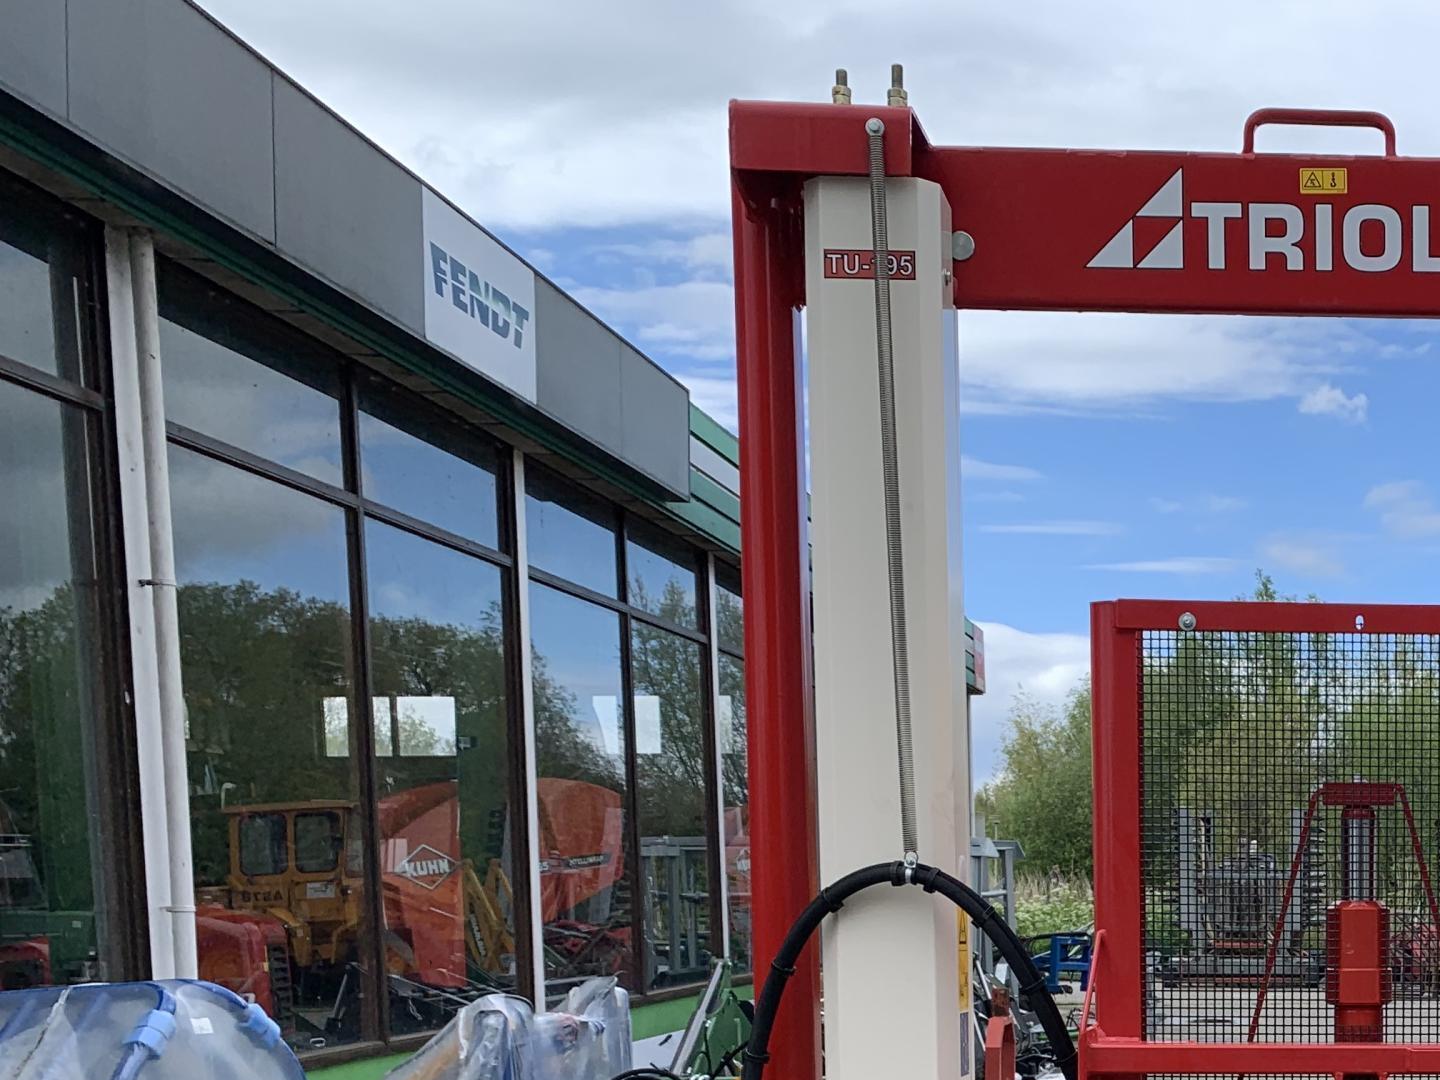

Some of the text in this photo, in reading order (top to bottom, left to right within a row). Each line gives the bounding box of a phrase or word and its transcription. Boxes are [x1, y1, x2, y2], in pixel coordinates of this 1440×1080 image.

[826, 254, 913, 275] TU-95
[429, 240, 530, 350] FENDT
[405, 858, 450, 877] KUHN
